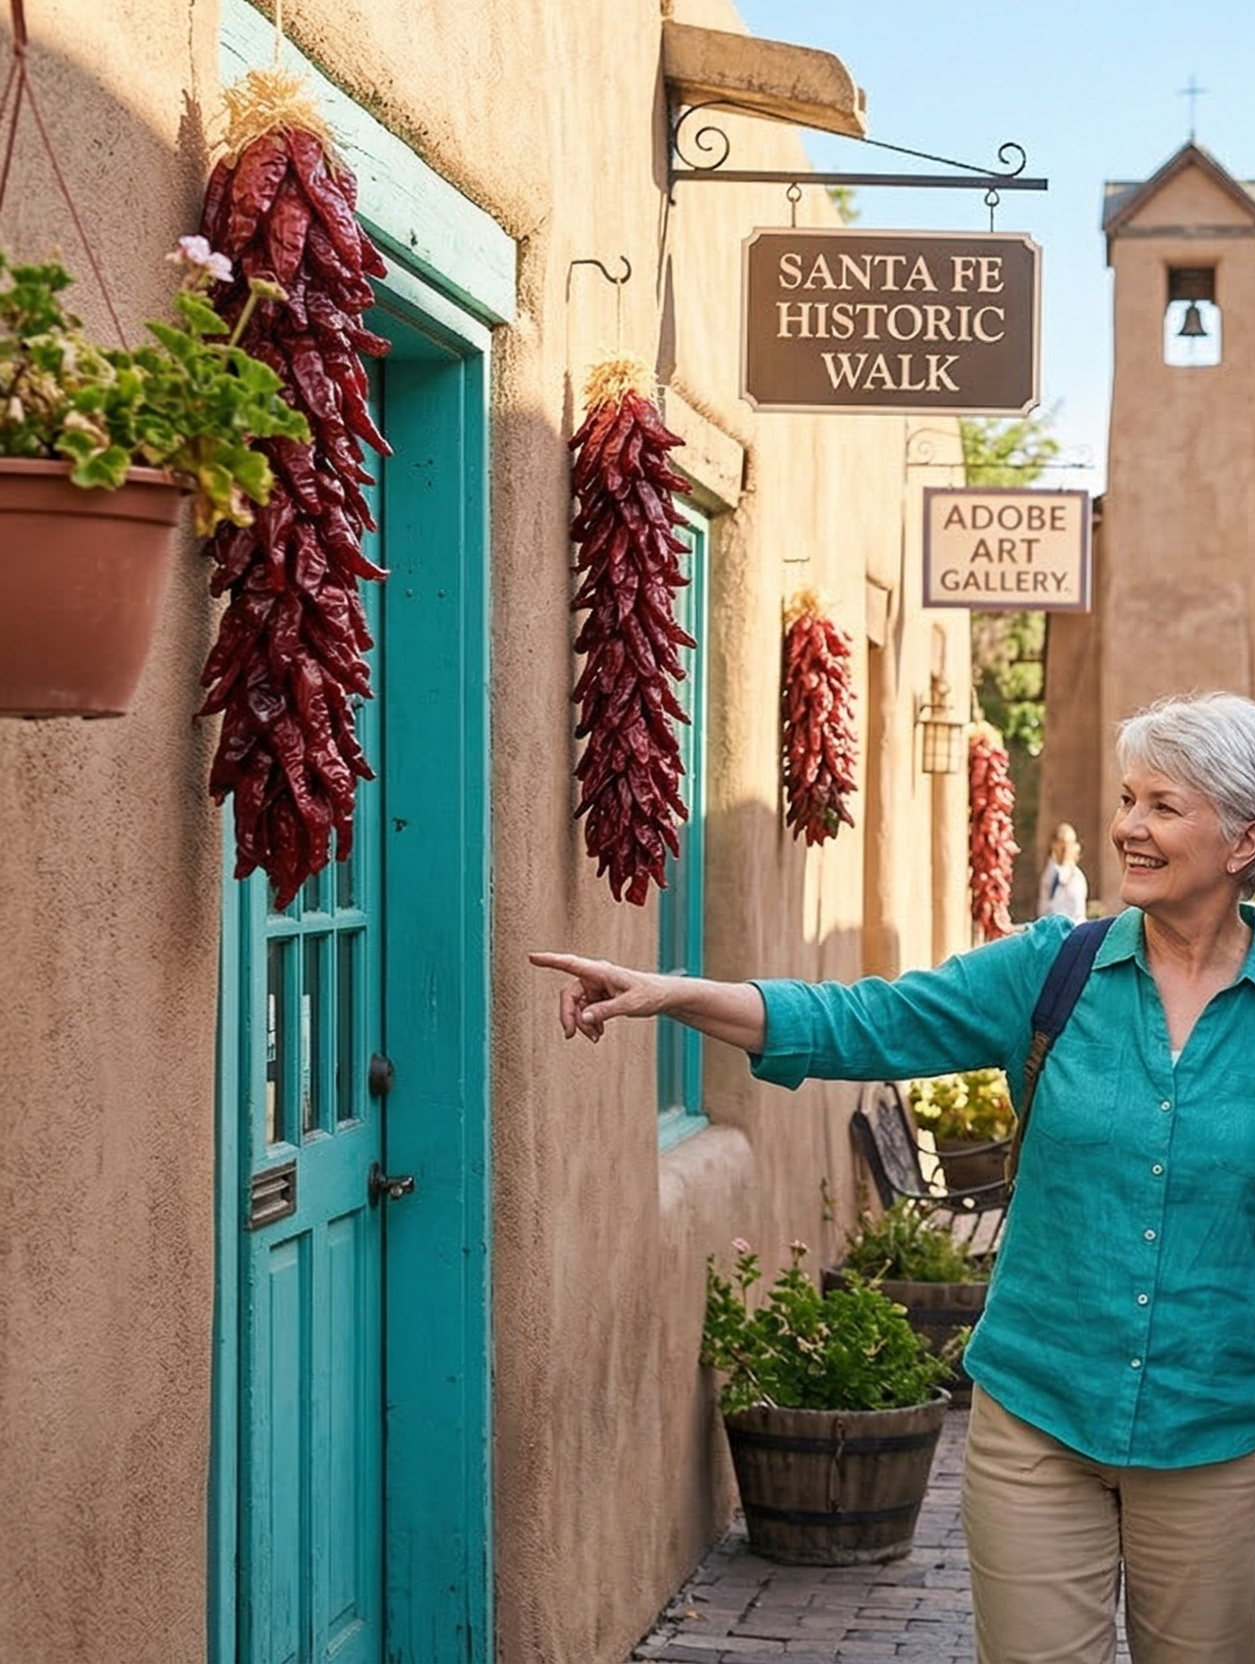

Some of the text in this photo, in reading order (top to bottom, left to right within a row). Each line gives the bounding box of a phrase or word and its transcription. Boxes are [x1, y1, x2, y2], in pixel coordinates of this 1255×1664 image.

[778, 253, 1005, 293] SANTA FE
[775, 302, 1005, 343] HISTORIC
[821, 352, 961, 392] WALK
[943, 504, 1067, 532] ADOBE
[970, 537, 1041, 564] ART
